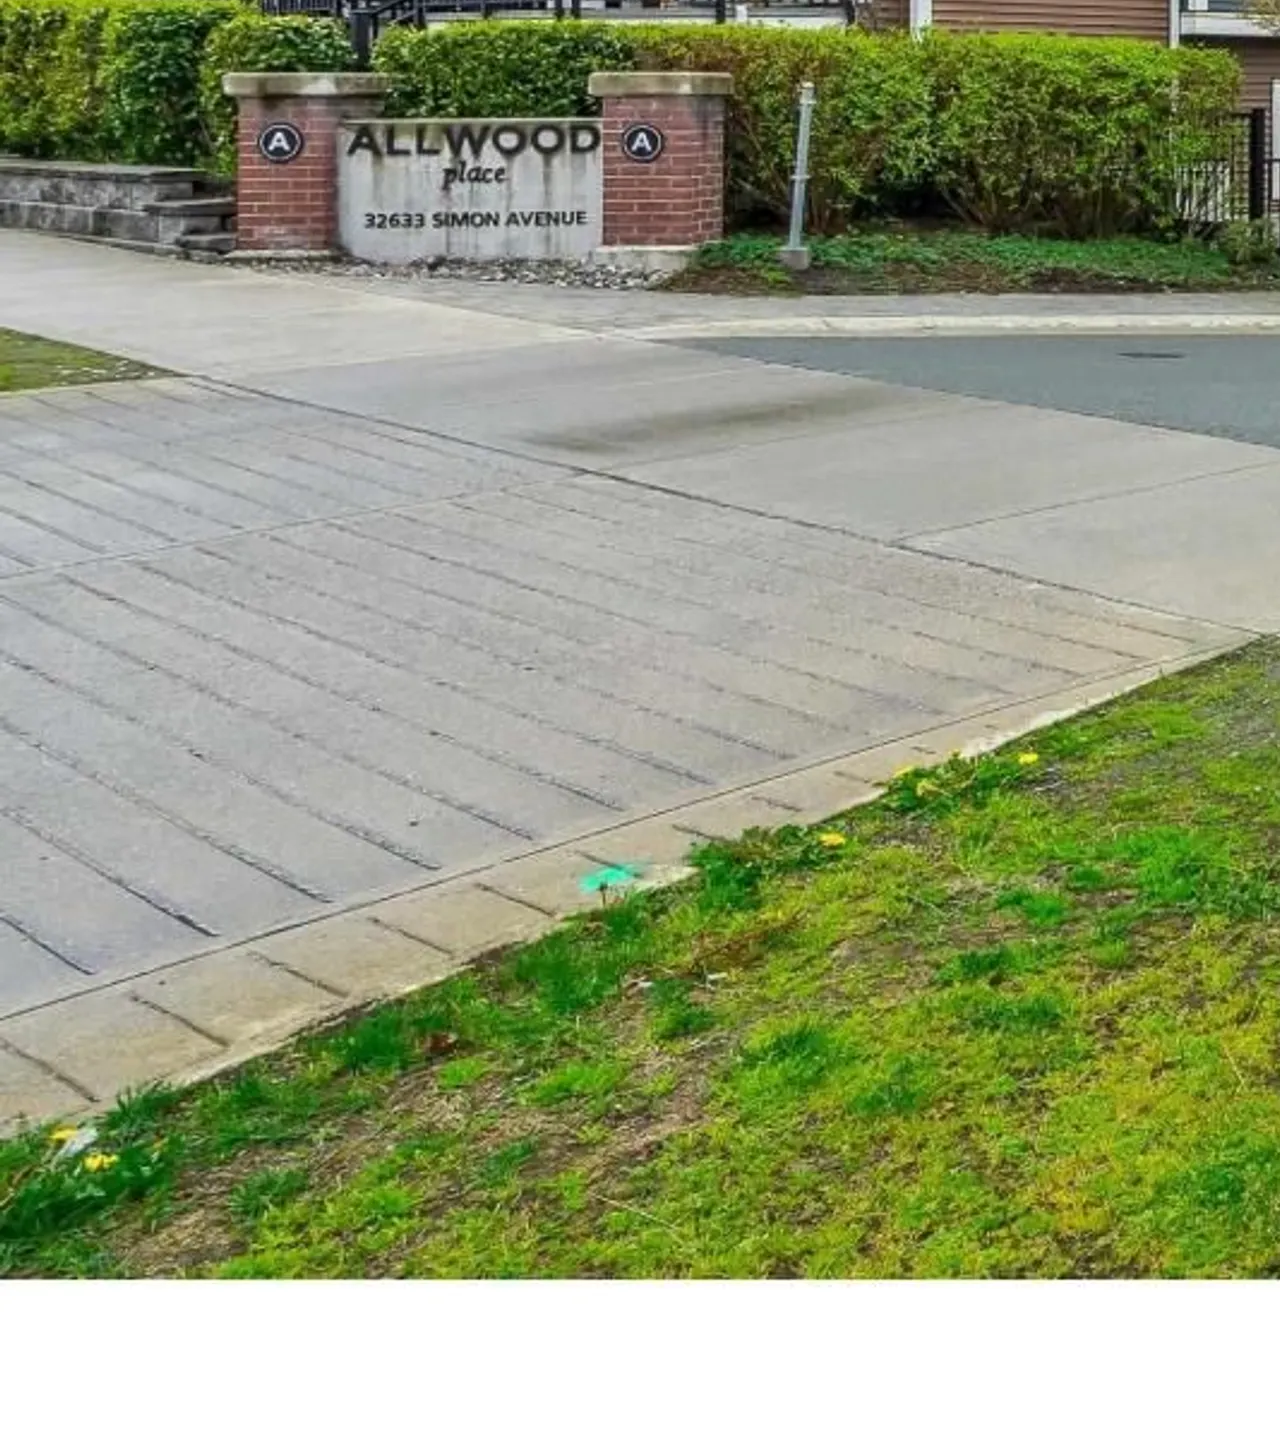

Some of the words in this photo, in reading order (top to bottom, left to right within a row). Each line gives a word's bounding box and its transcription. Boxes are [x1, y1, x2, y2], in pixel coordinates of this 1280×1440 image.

[347, 124, 600, 157] ALLWOOD
[442, 162, 506, 191] place
[364, 212, 425, 229] 32633
[432, 212, 500, 228] SIMON
[505, 210, 588, 227] AVENUE
